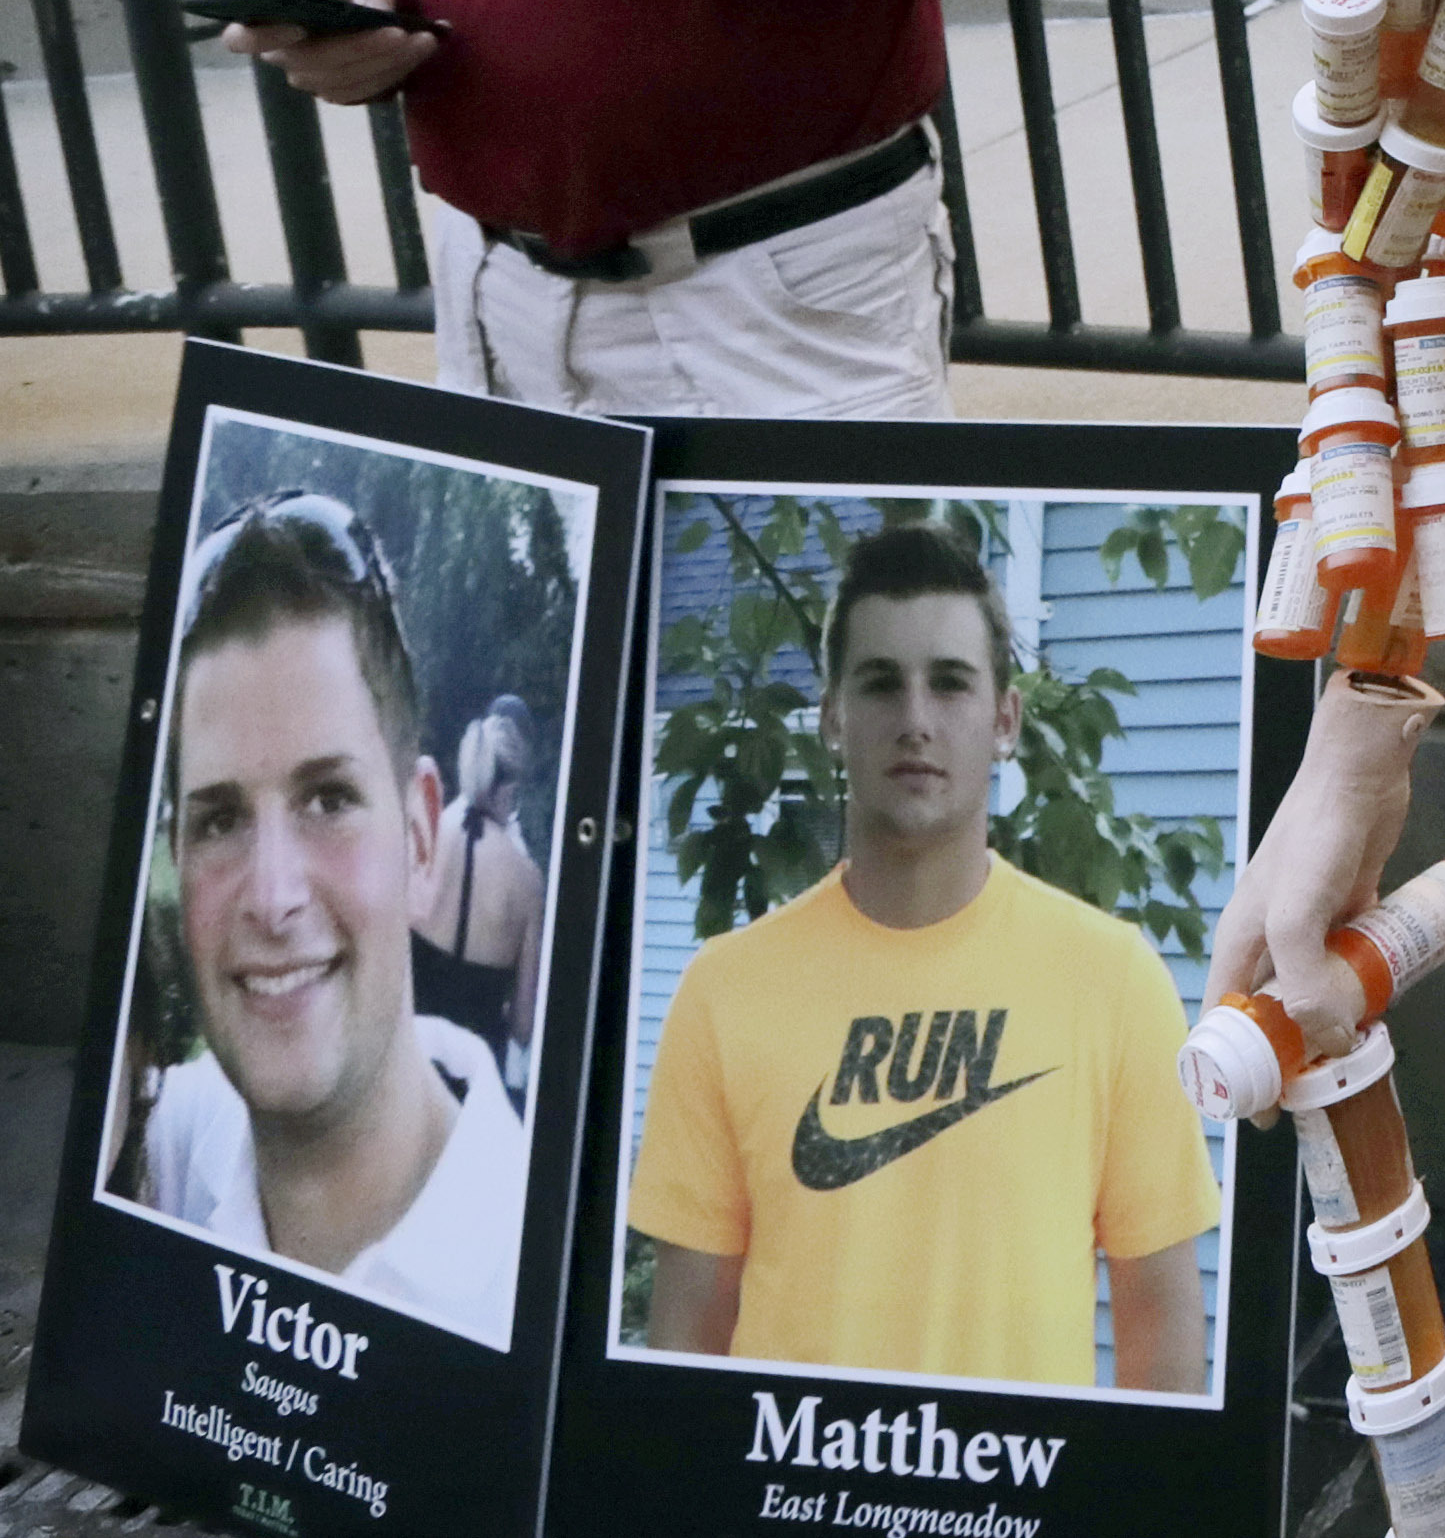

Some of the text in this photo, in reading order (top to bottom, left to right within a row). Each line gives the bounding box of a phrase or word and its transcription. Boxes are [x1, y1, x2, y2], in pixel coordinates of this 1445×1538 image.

[829, 1008, 1009, 1105] RUN
[213, 1264, 368, 1380] Victor
[241, 1361, 319, 1416] Saugus
[161, 1390, 389, 1518] Intelligent / Caring
[745, 1390, 1066, 1488] Matthew
[239, 1483, 295, 1525] T.I.M.
[759, 1483, 1041, 1538] East Longmeadow
